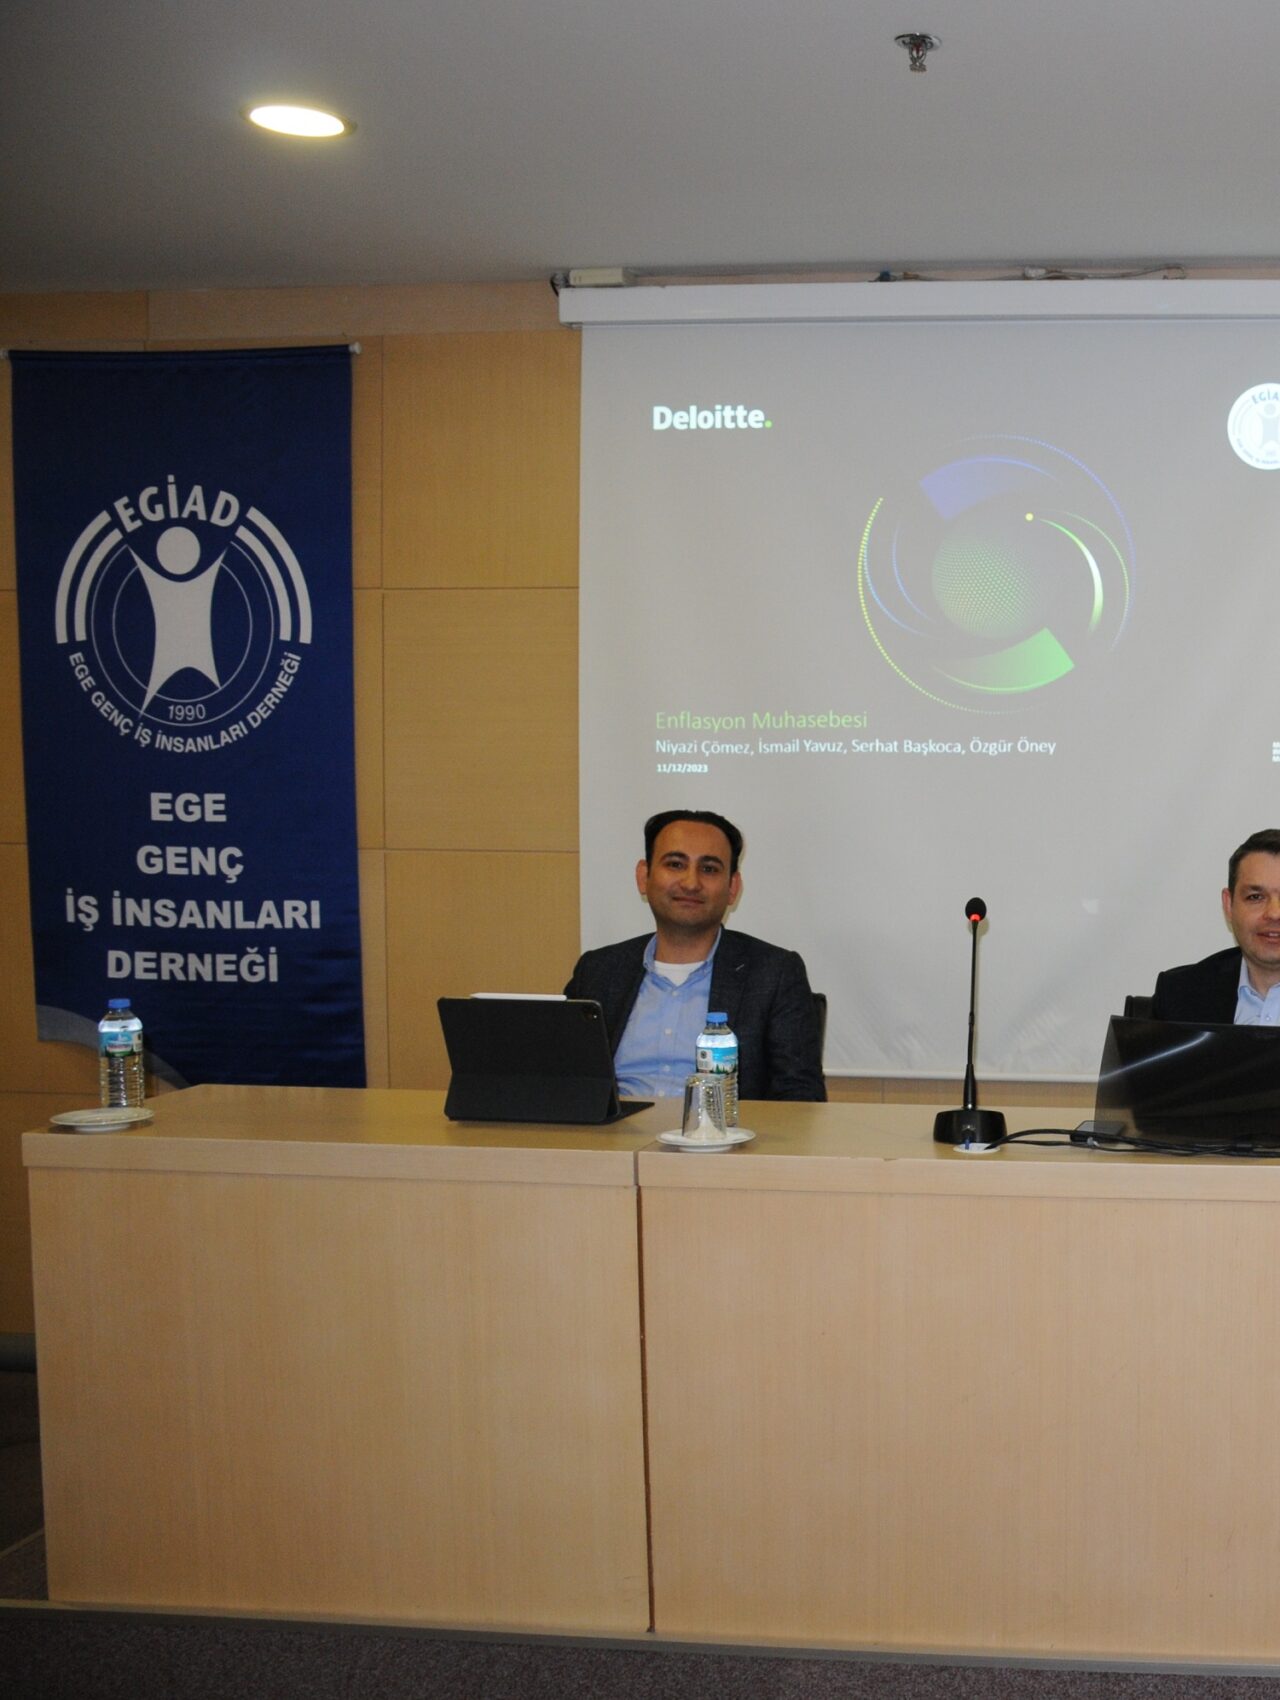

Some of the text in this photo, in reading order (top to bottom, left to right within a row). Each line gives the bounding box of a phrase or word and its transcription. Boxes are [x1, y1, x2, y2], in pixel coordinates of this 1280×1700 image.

[653, 404, 773, 430] Deloitte.
[114, 475, 240, 533] EGİAD
[69, 651, 302, 752] EGE GENÇ İŞ İNSANLARI DERNEĞİ
[168, 704, 206, 721] 1990
[656, 710, 868, 733] Enflasyon Muhasebesi
[655, 736, 1056, 756] Niyazi Çömez, İsmail Yavuz, Serhat Başkoca, Özgür Öney
[656, 763, 709, 773] 11/12/2023
[150, 792, 227, 822] EGE
[136, 845, 244, 883] GENÇ
[65, 888, 321, 932] İŞ İNSANLARI
[107, 947, 279, 982] DERNEĞİ
